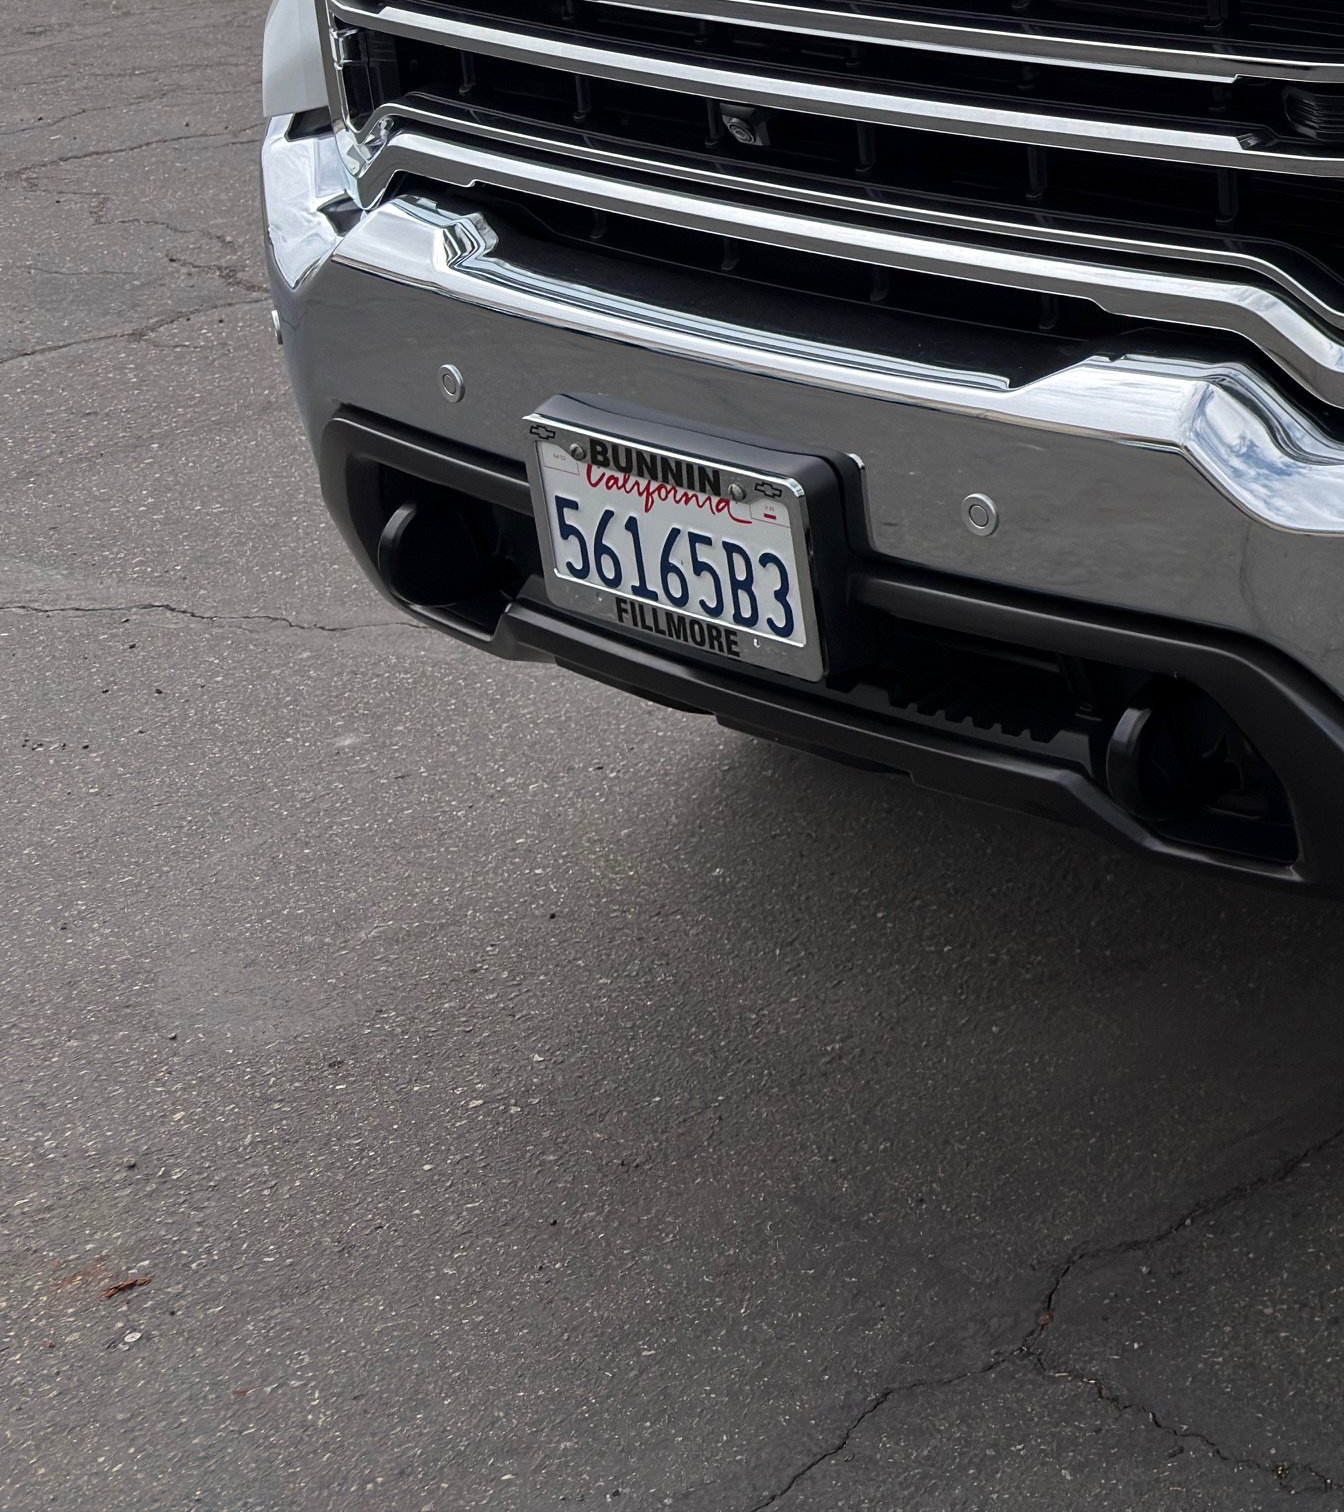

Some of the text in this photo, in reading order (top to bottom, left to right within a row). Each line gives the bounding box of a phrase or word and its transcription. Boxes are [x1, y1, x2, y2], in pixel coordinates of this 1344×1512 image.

[585, 463, 752, 524] California
[589, 439, 721, 497] BUNNIN
[554, 495, 795, 638] 56165B3
[615, 597, 741, 658] FILLMORE
